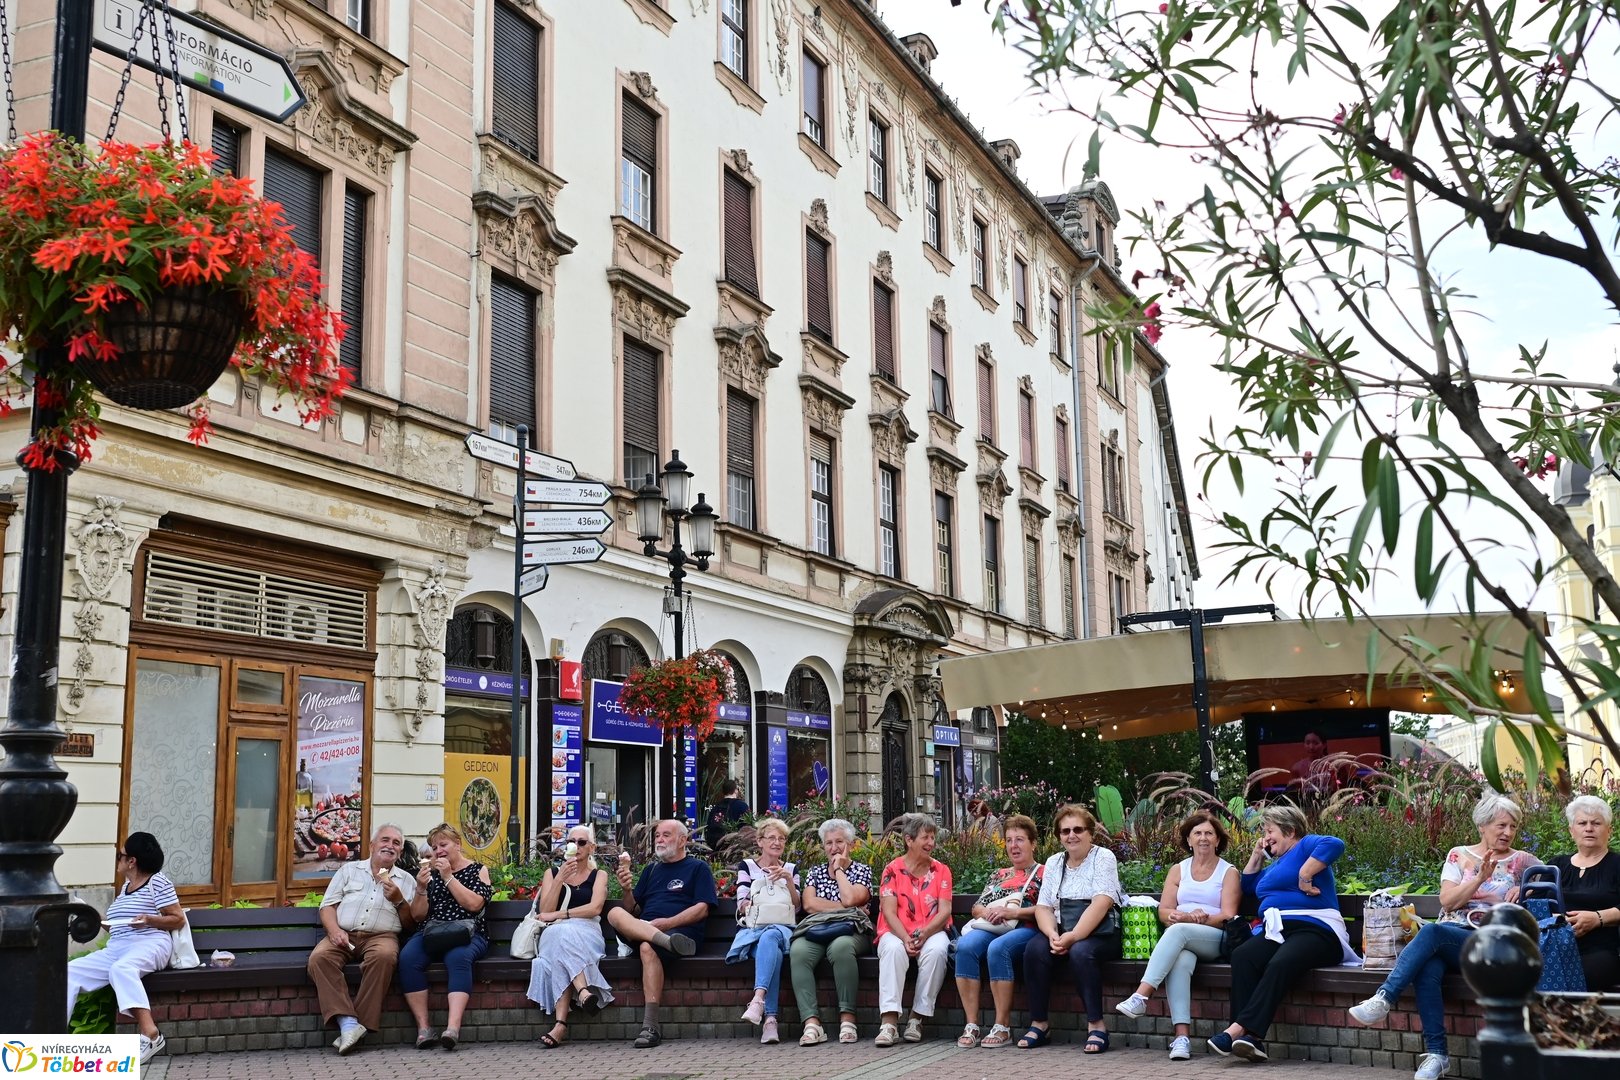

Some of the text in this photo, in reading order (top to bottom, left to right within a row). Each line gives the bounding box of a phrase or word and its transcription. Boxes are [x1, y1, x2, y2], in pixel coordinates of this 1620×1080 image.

[171, 29, 253, 73] NFORMÁCIÓ
[176, 48, 241, 84] INFORMATION
[579, 488, 603, 498] 754KM
[577, 516, 601, 526] 436KM
[572, 545, 595, 555] 246KM
[299, 686, 361, 713] Mozzarella
[310, 713, 355, 737] Pizzéria
[935, 730, 957, 741] OPTIKA
[301, 736, 360, 751] www.mozzarellapizzeria.hu
[320, 745, 360, 762] 42/424-008
[463, 760, 499, 772] GEDEON
